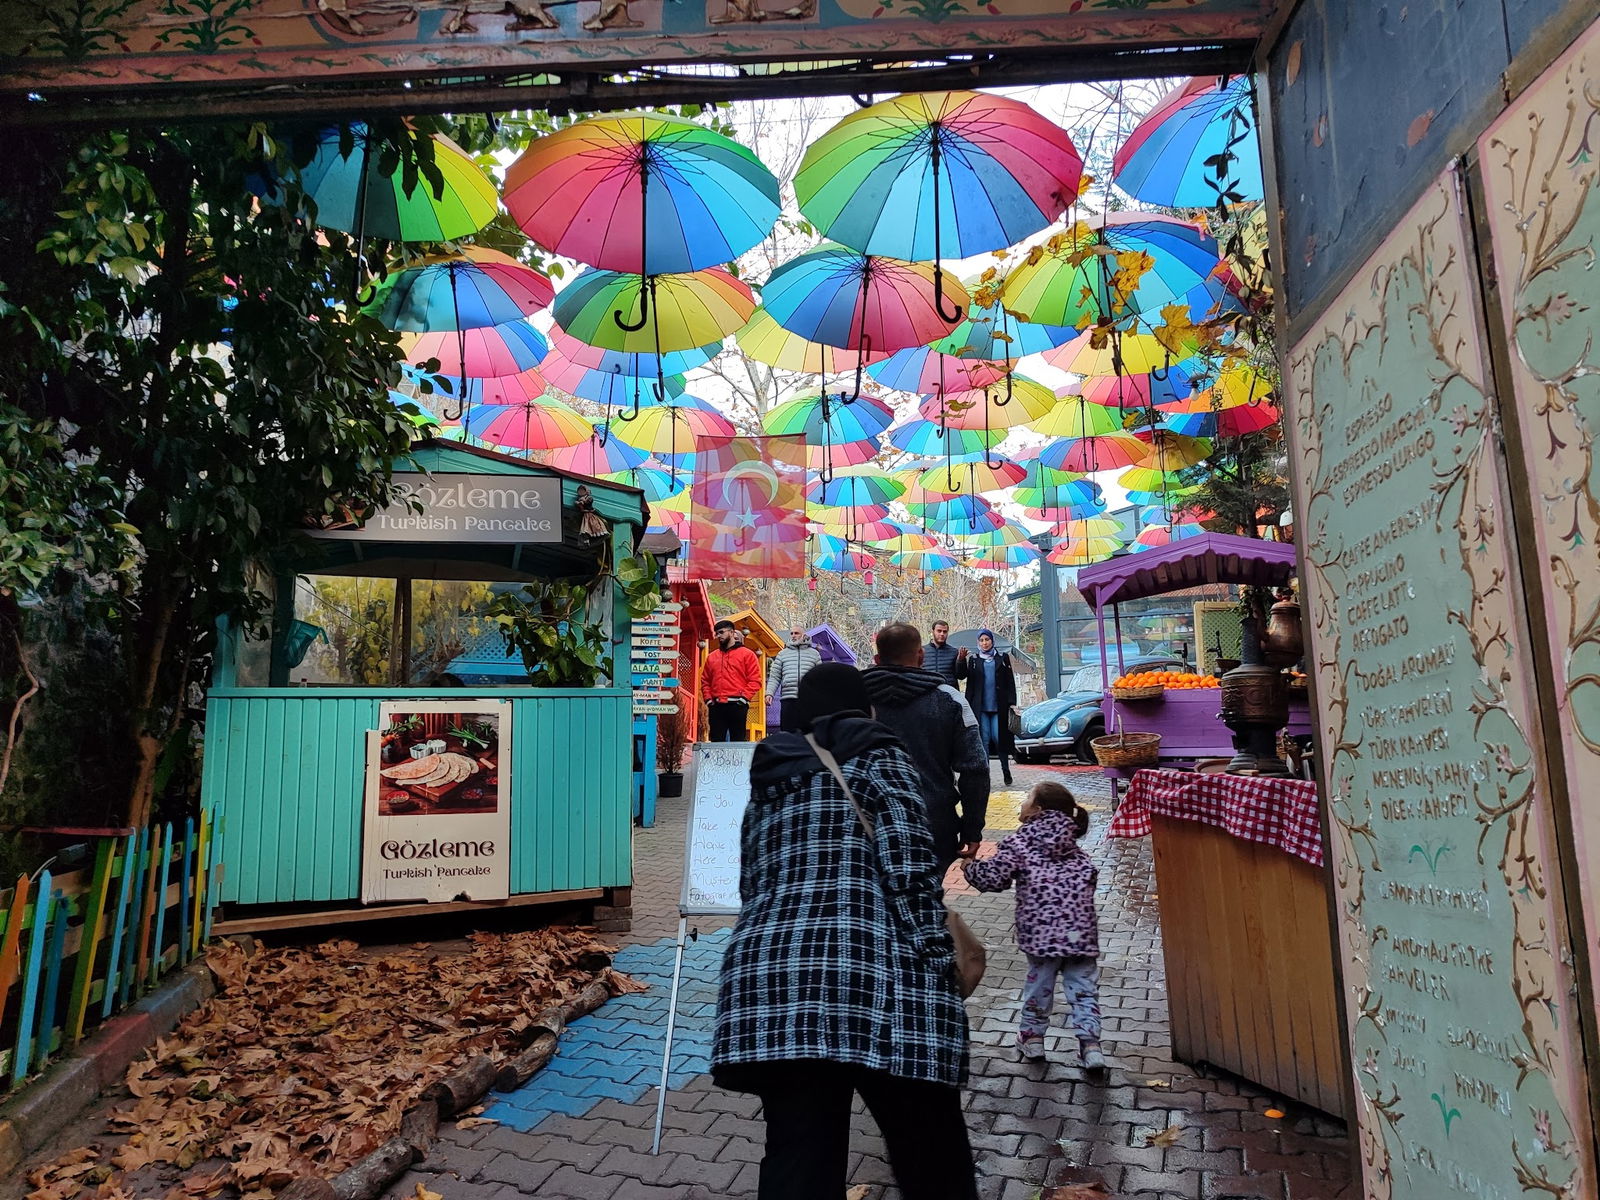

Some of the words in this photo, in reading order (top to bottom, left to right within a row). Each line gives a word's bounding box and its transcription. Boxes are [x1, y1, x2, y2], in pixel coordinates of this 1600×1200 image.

[1346, 392, 1393, 446] ESPRESSO
[1332, 437, 1379, 485] ESPRESSO
[1343, 461, 1393, 508] ESPRESSO
[1392, 427, 1436, 472] LUNGO
[389, 481, 541, 509] Gözleme
[377, 513, 457, 531] Turkish
[464, 515, 551, 532] Pancake
[1353, 614, 1409, 652] AFFOGATO
[644, 651, 661, 659] TOST
[632, 664, 660, 672] ALATA
[380, 838, 496, 861] Gözleme
[382, 867, 433, 880] Turkish
[436, 865, 492, 878] Pancake
